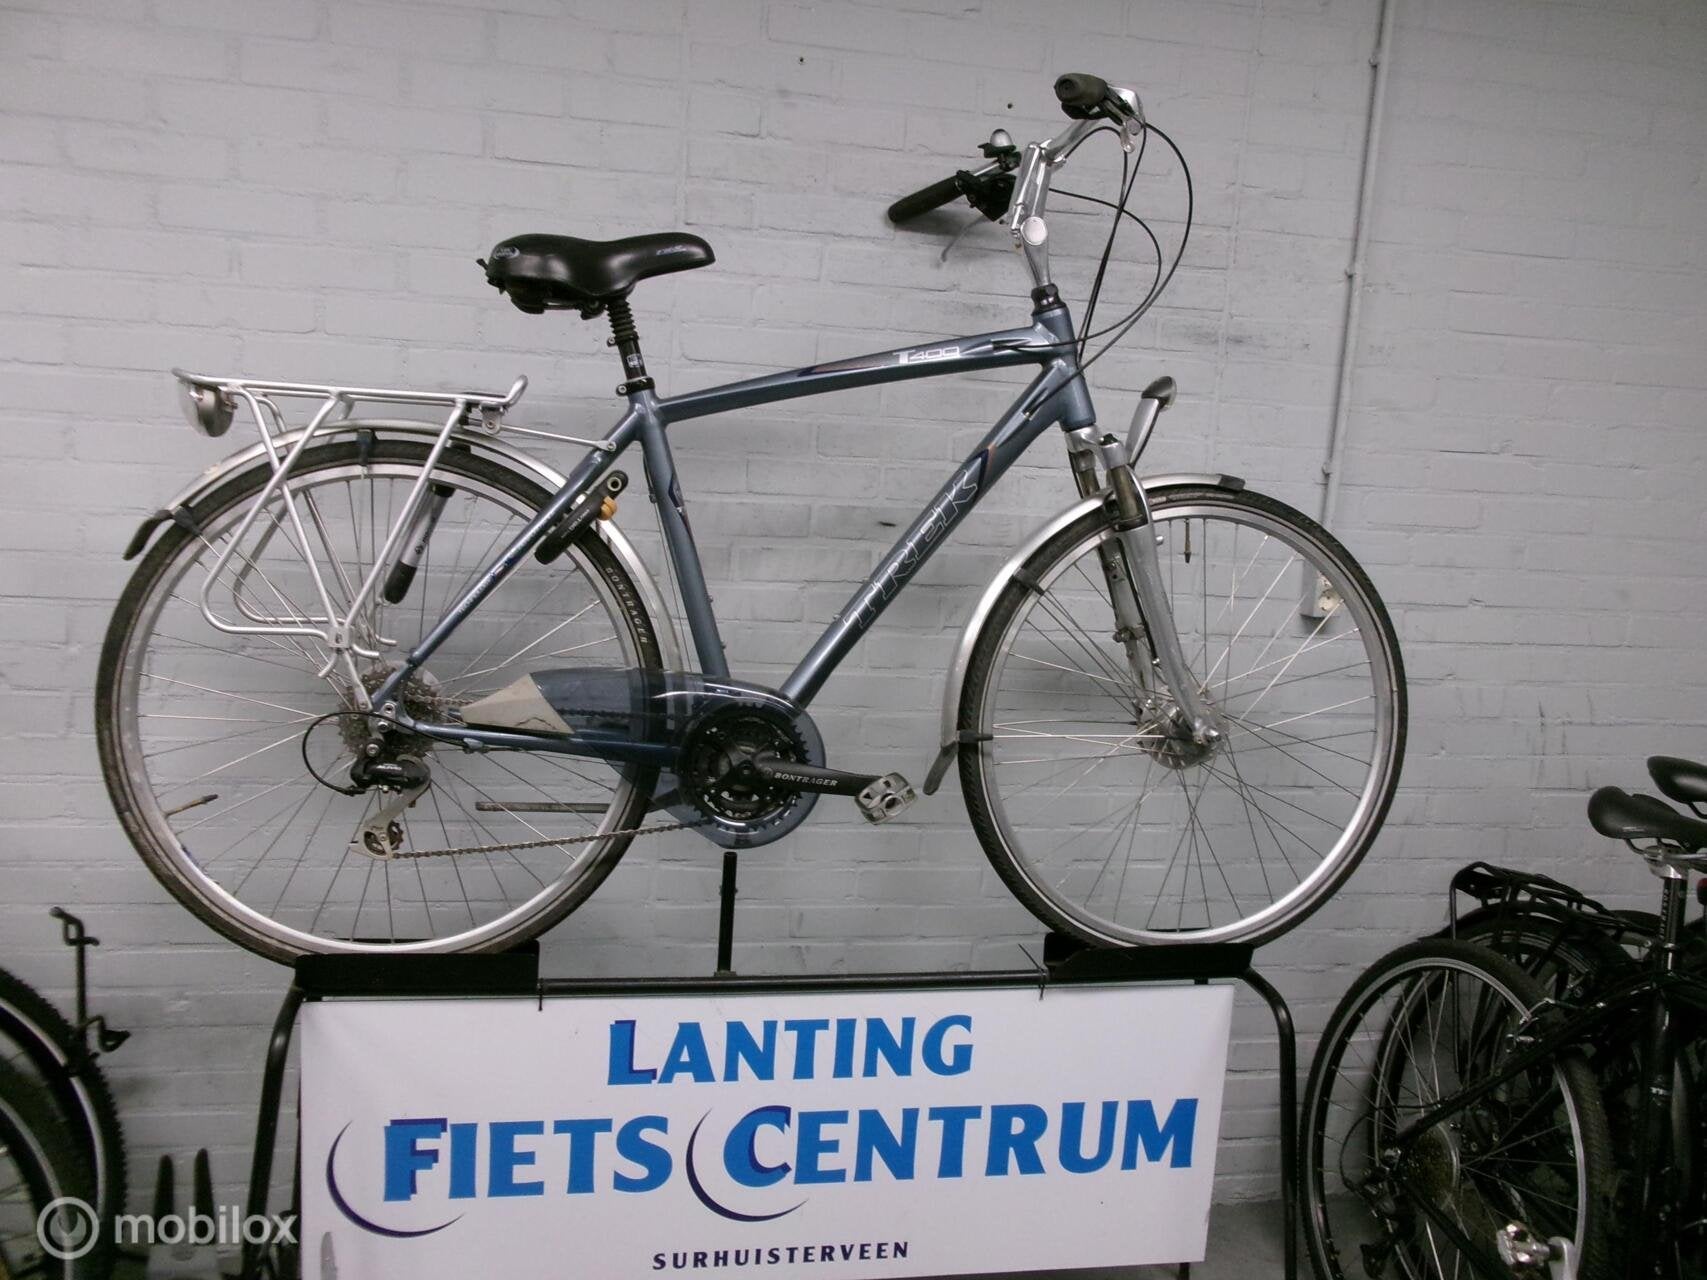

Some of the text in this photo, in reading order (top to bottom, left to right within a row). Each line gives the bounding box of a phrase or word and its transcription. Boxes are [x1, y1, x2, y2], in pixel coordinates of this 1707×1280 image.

[892, 346, 960, 365] T400
[842, 469, 978, 629] TREK
[605, 566, 648, 644] BONTRAGER
[774, 772, 838, 787] BONTRAGER
[607, 1015, 973, 1085] LANTING
[384, 1097, 1198, 1202] FIETS CENTRUM
[653, 1241, 909, 1270] SURHUISTERVEEN
